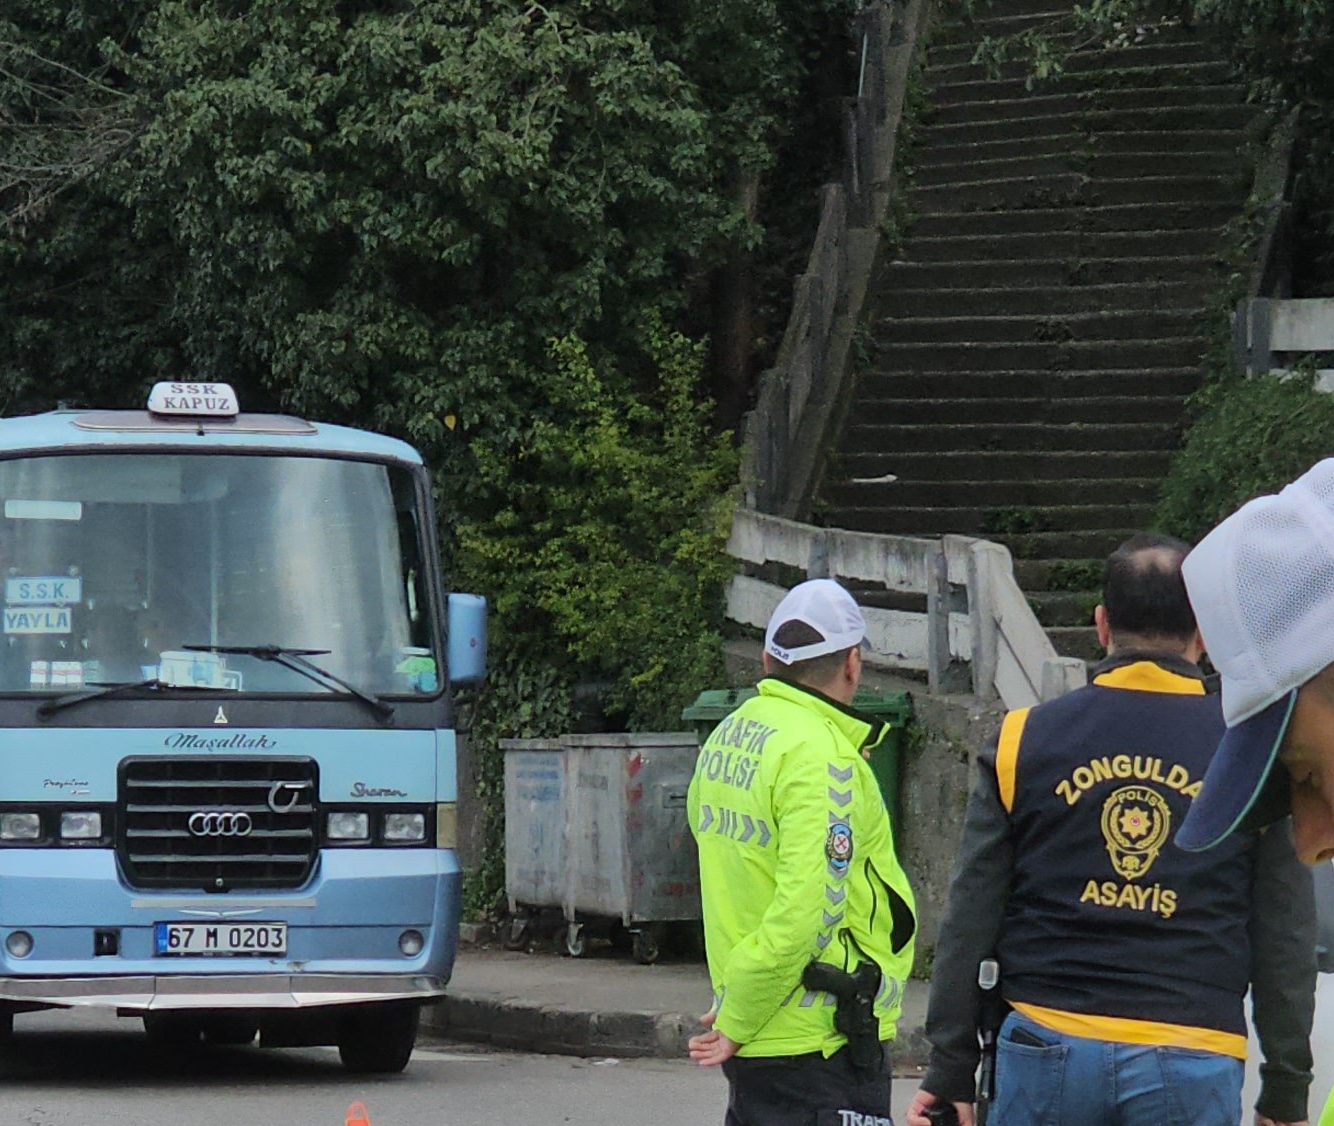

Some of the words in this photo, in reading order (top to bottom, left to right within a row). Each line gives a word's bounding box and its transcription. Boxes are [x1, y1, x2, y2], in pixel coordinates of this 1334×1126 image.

[170, 384, 218, 394] SSK
[163, 397, 230, 410] KAPUZ
[19, 583, 68, 599] S.S.K.
[5, 612, 68, 629] YAYLA
[1055, 754, 1204, 806] ZONGULDA
[1117, 790, 1159, 806] POLİS
[1079, 879, 1178, 918] ASAYİŞ
[168, 928, 195, 948] 67
[205, 928, 218, 948] M
[229, 928, 283, 948] 0203
